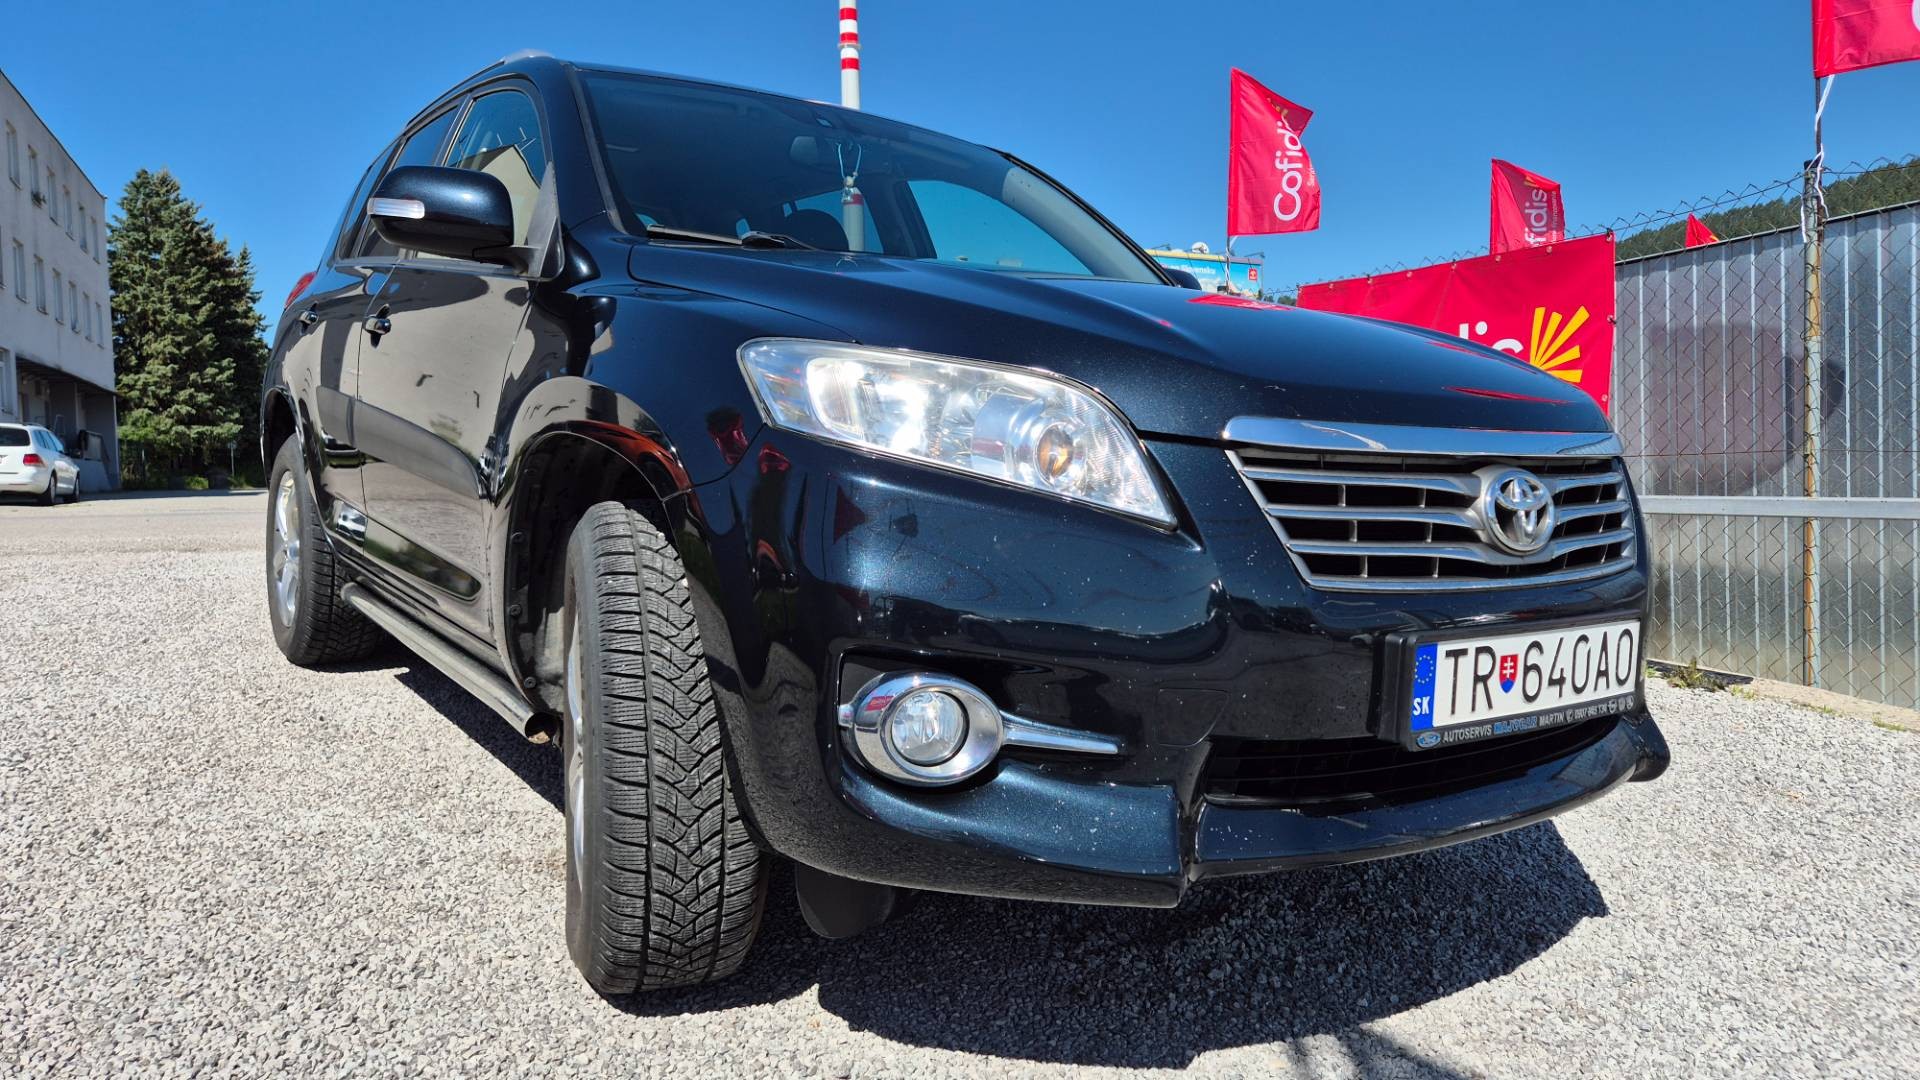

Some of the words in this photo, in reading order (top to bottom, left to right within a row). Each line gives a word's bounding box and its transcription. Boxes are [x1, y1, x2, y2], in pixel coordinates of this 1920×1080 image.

[1445, 645, 1496, 715] TR
[1413, 696, 1430, 715] SK
[1442, 724, 1493, 743] AUTOSERVIS
[1539, 711, 1564, 726] MARTIN
